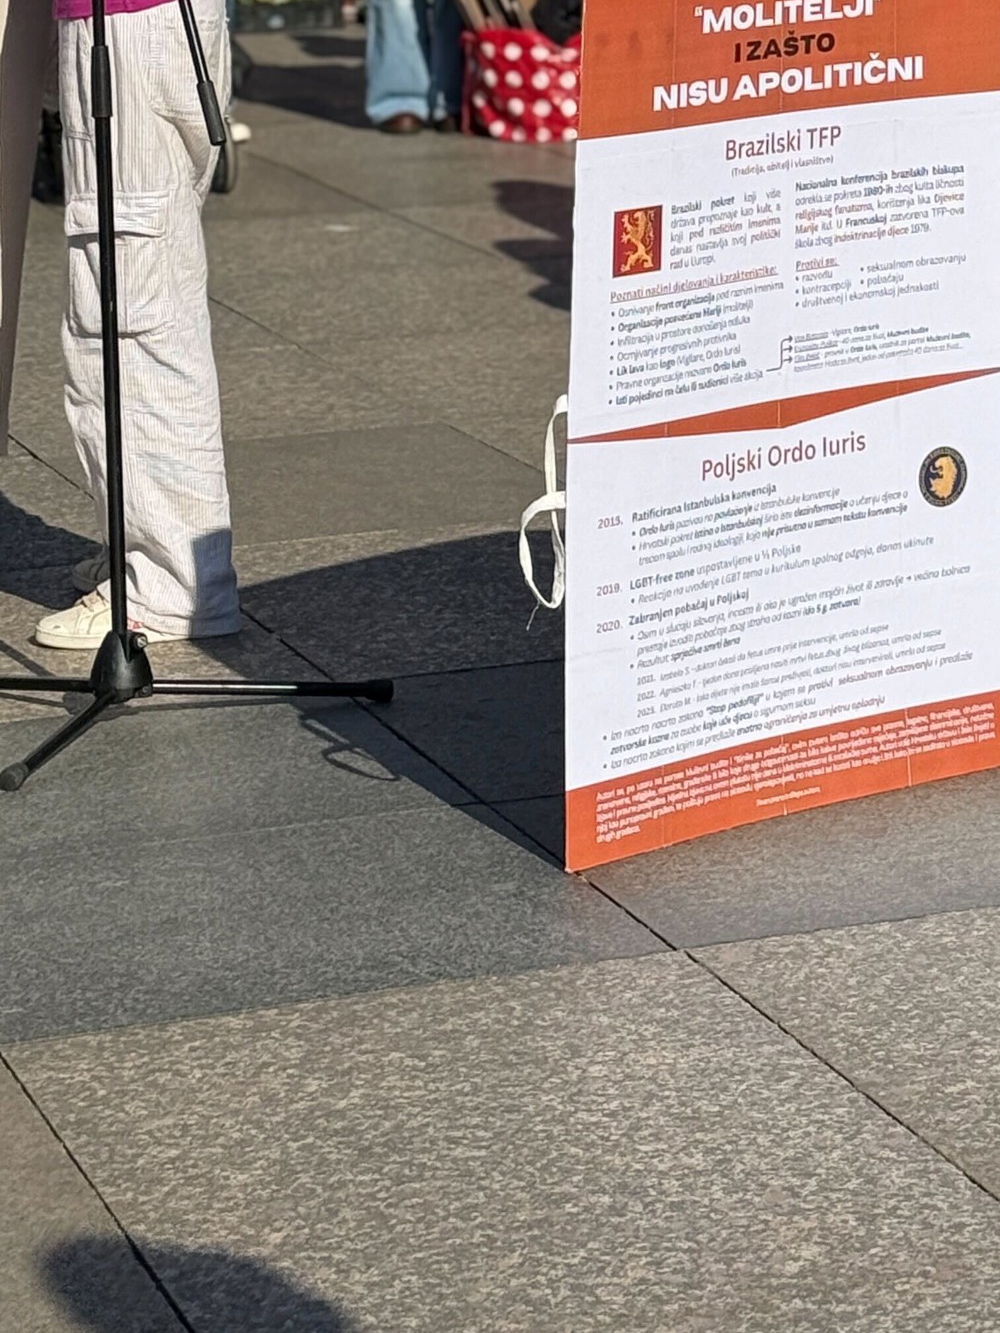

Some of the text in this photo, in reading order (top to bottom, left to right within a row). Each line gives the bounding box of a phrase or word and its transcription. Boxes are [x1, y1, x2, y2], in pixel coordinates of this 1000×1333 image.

[734, 31, 835, 63] I ZAŠTO
[653, 52, 924, 111] NISU APOLITIČNI
[725, 126, 841, 161] Brazilski TFP
[701, 431, 866, 482] Poljski Ordo Iuris
[631, 504, 682, 523] Ratificirana
[683, 493, 730, 512] Istanbulska
[674, 568, 695, 580] zone
[596, 619, 623, 634] 2020.
[628, 608, 673, 626] Zabranjen
[674, 598, 708, 617] pobačaj
